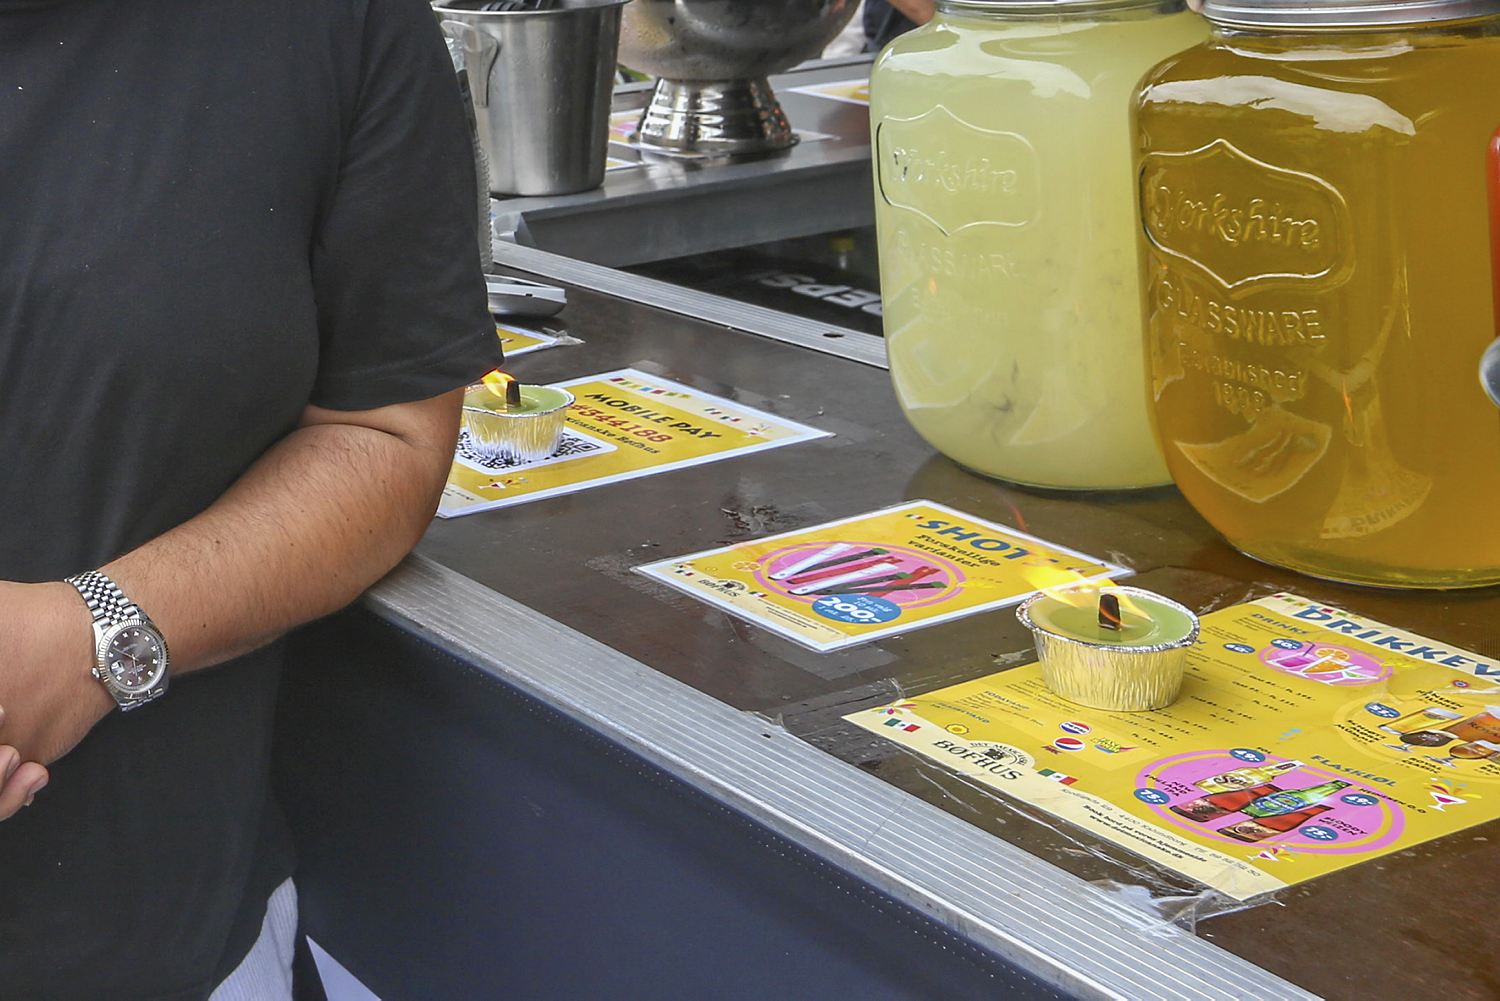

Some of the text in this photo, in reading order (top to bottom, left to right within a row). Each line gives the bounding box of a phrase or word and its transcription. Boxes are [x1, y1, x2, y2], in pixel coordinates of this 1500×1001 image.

[1153, 185, 1320, 249] Yorkshire
[1157, 279, 1329, 347] GLASSWARE
[584, 393, 723, 440] MOBILE PAY
[907, 540, 981, 568] varianter
[914, 534, 1001, 567] Forskellige
[817, 596, 883, 623] 200,-
[1292, 607, 1500, 684] DRIKKEV
[931, 740, 1025, 780] BØFHUS
[1310, 755, 1397, 788] FLASKEØL
[1139, 789, 1165, 803] 75,-
[1171, 781, 1195, 793] NEW
[1083, 804, 1103, 817] Book
[1304, 827, 1333, 841] 75,-
[1318, 818, 1359, 836] WEIZEN
[1323, 816, 1368, 836] BLOODY
